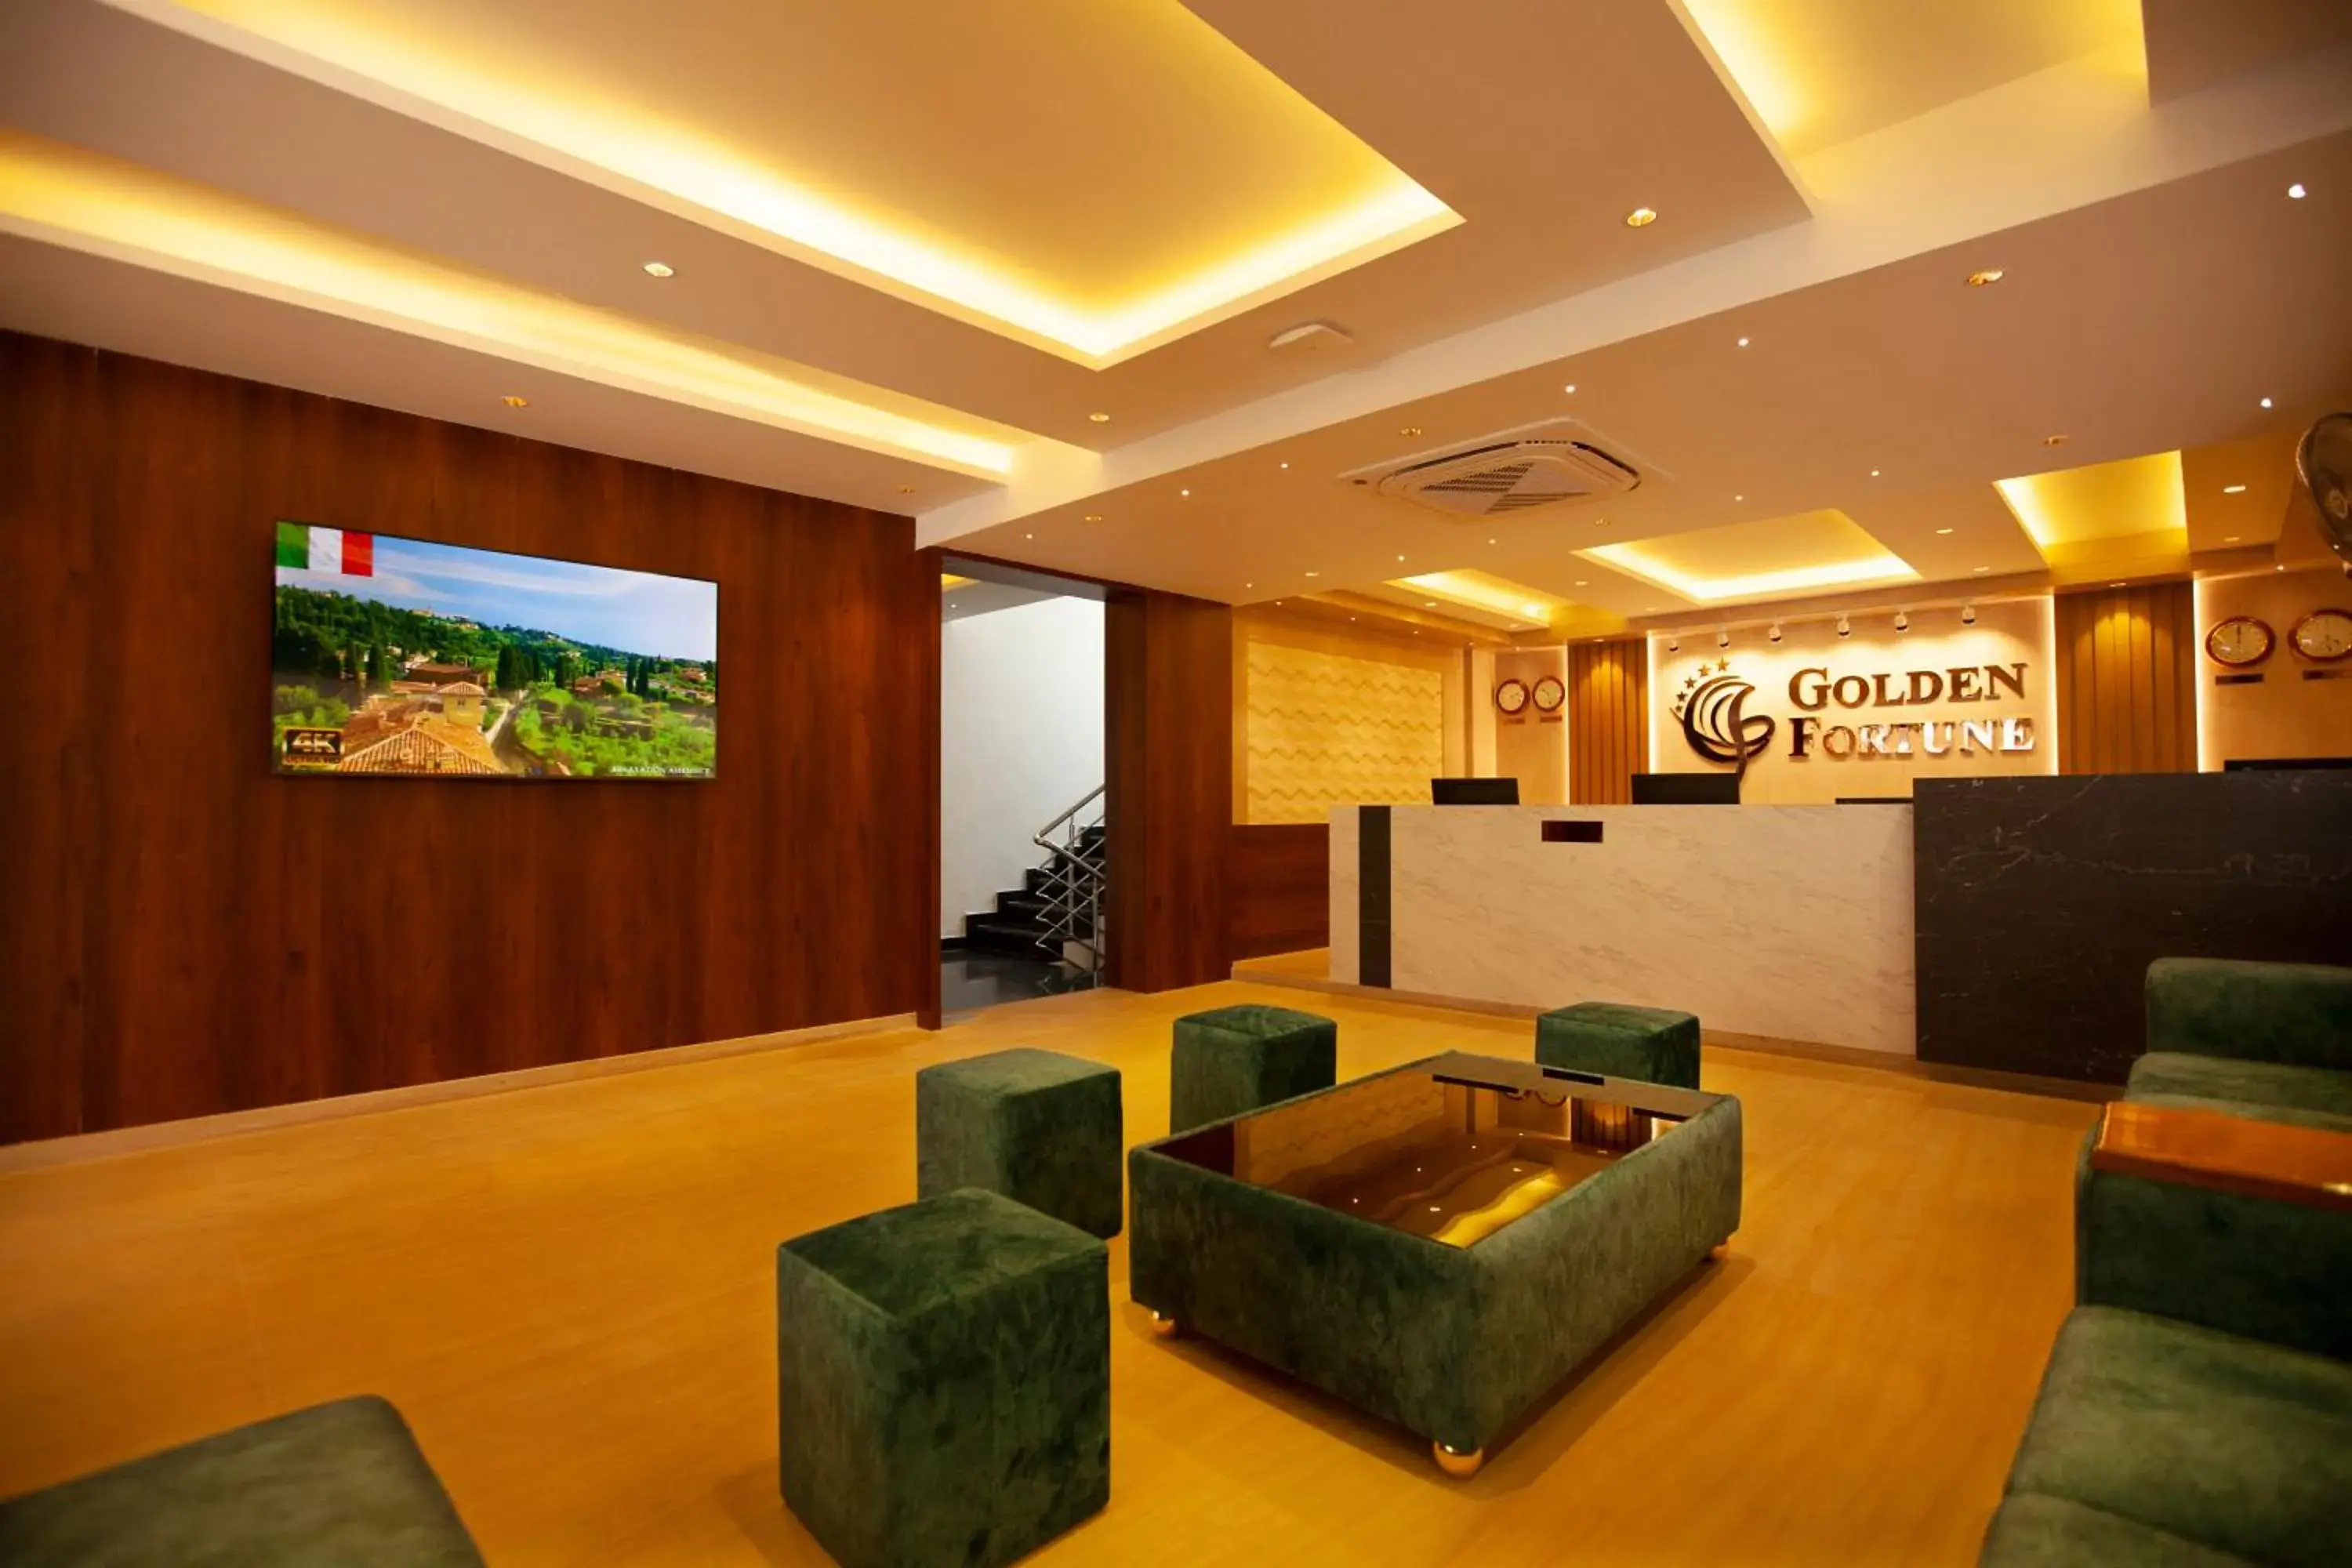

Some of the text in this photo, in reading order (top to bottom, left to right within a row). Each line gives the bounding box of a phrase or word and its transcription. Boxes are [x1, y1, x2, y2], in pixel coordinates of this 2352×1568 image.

[1788, 662, 2028, 712] GOLDEN
[292, 732, 337, 753] 4K
[1788, 716, 2035, 760] FORTUNE
